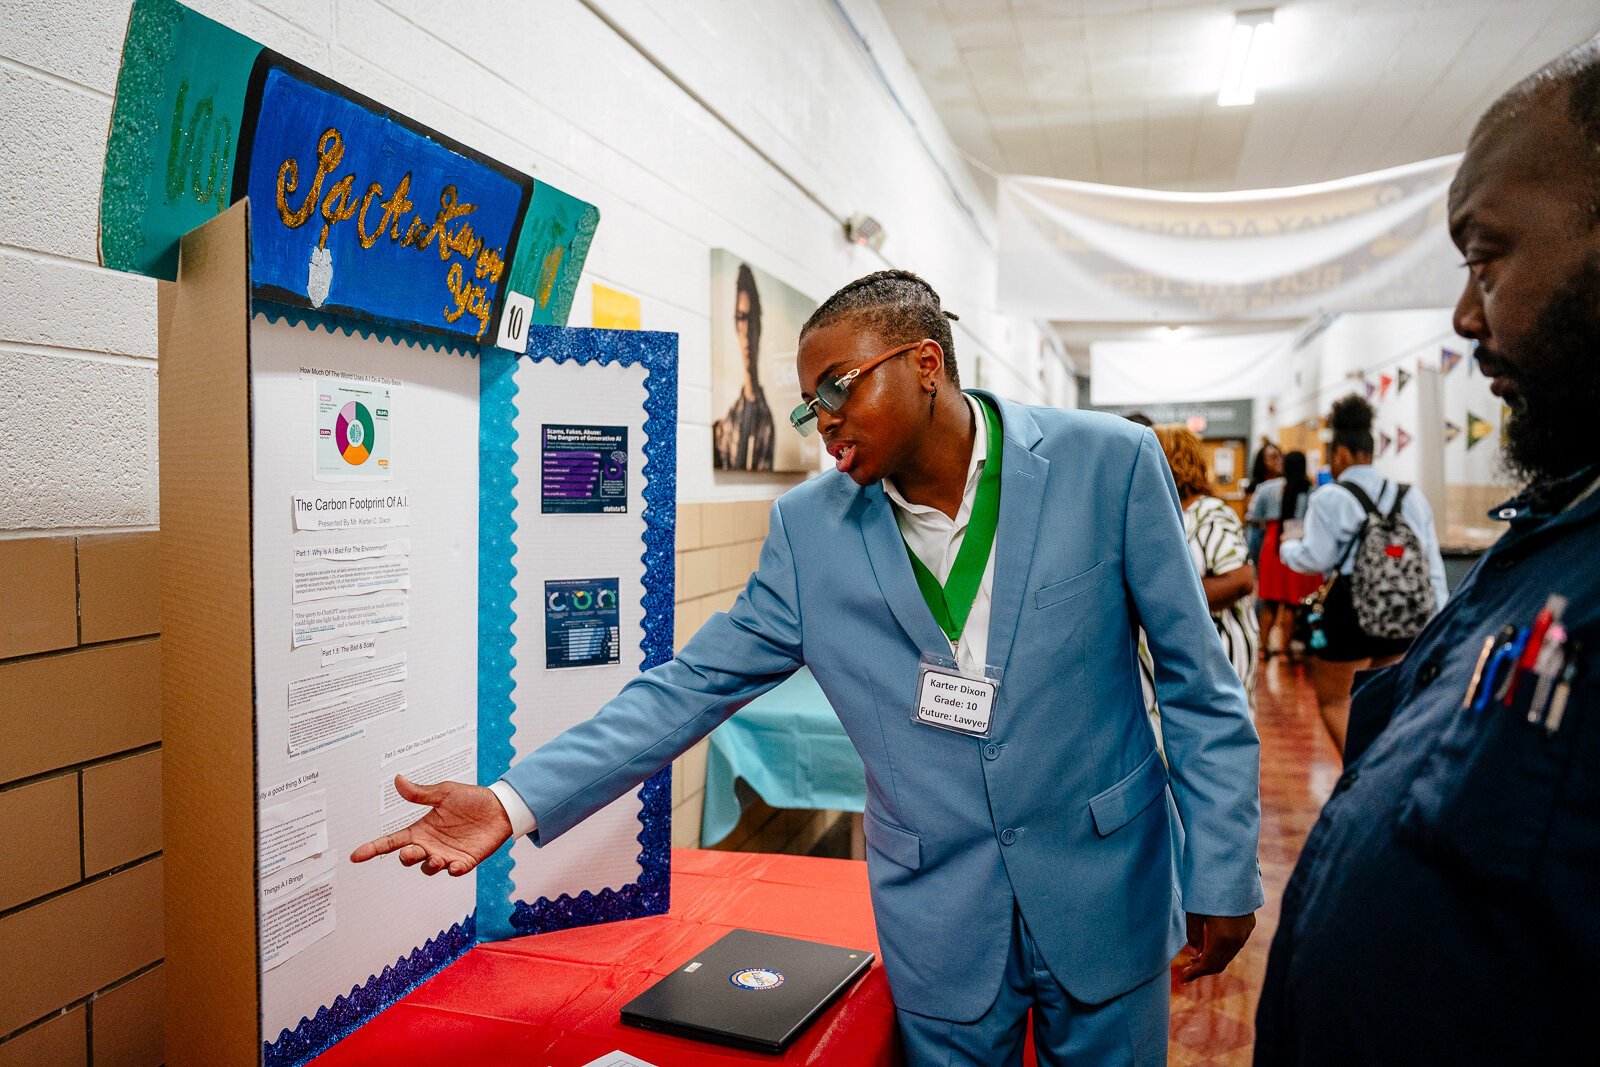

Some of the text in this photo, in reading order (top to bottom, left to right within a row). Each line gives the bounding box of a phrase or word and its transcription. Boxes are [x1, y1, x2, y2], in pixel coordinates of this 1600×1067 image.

[507, 305, 524, 340] 10
[312, 368, 324, 376] Much
[296, 496, 408, 511] The Carbon Footprint Of A.I.
[344, 518, 350, 527] By
[930, 678, 986, 698] Karter Dixon
[934, 695, 978, 711] Grade: 10
[920, 706, 987, 728] Future: Lawyer
[272, 785, 284, 796] good
[285, 780, 297, 790] thing
[302, 771, 319, 782] Useful
[264, 884, 280, 896] Things
[288, 874, 304, 884] Brings
